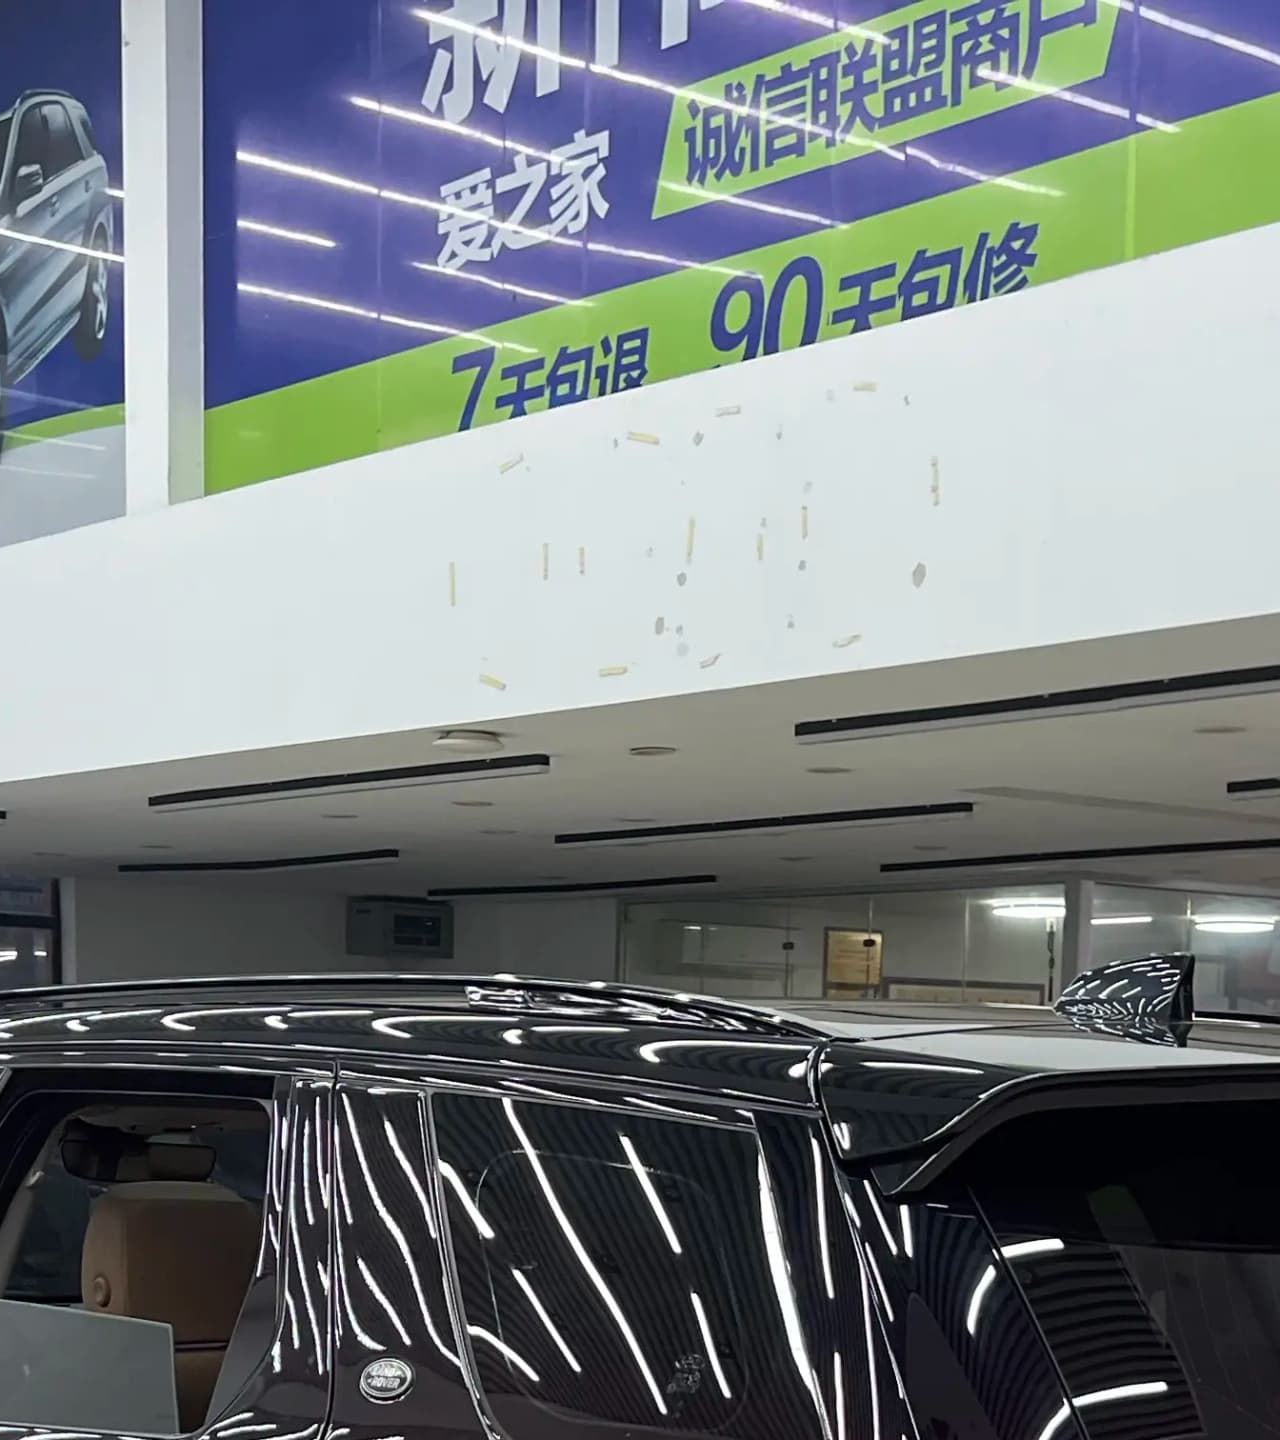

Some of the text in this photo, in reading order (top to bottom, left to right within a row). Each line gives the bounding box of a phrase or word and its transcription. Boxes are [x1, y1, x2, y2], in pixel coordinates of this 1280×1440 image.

[684, 0, 1097, 187] 诚信联盟商户
[436, 128, 610, 272] 爱之家
